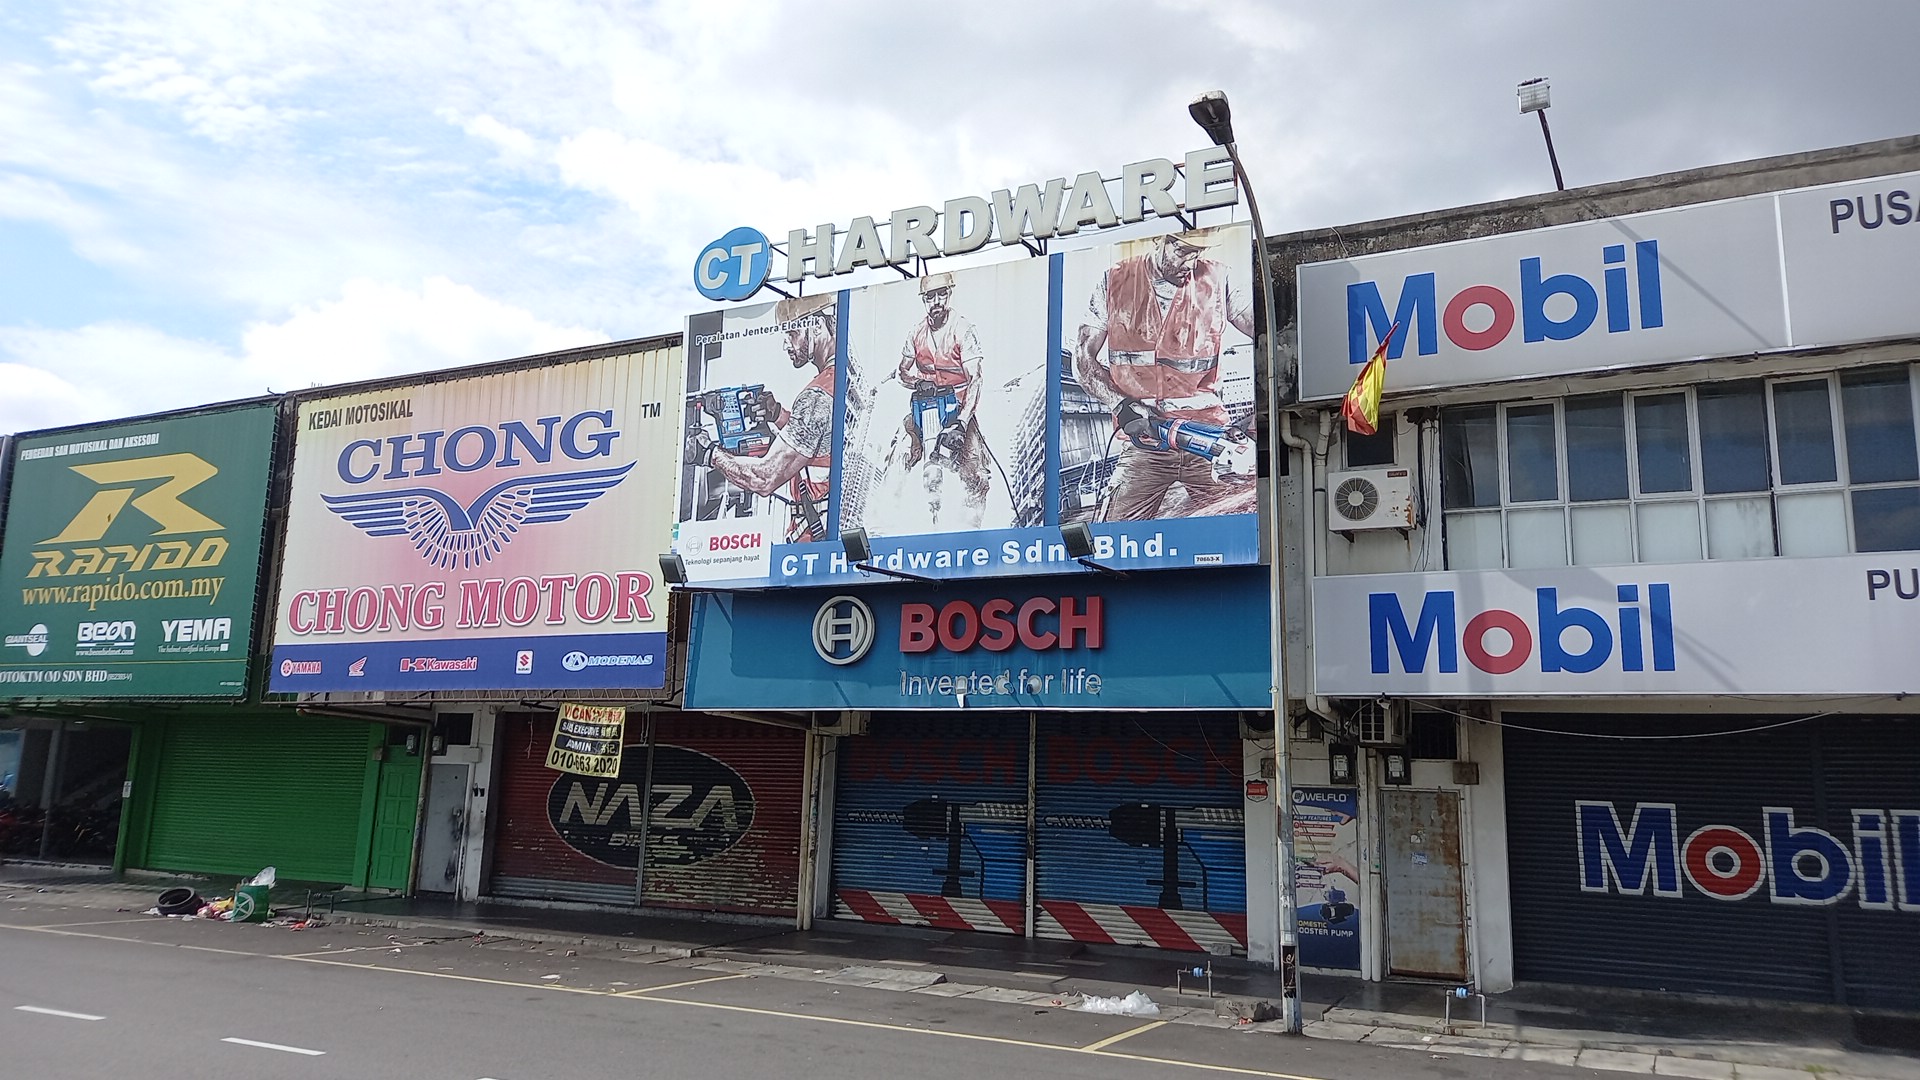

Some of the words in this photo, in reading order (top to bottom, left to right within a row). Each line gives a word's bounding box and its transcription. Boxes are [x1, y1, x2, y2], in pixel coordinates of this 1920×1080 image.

[787, 145, 1239, 284] HARDWARE
[1829, 190, 1920, 234] PUS
[698, 242, 763, 290] CT
[1346, 239, 1664, 365] Mobil
[695, 331, 741, 346] Peralatan
[742, 324, 779, 337] Jentera
[781, 317, 821, 331] Elektrik
[308, 408, 342, 430] KEDAI
[345, 399, 413, 426] MOTOSIKAL
[641, 402, 661, 419] TM
[69, 440, 108, 455] MOTOSIKAL
[109, 437, 124, 450] DAN
[124, 433, 160, 448] AKSESORI
[337, 409, 620, 484] CHONG
[709, 533, 761, 551] BOSCH
[781, 552, 819, 576] CT
[829, 548, 990, 574] Hrdware
[1094, 532, 1178, 560] Bhd.
[25, 537, 230, 578] RAPIDO
[685, 556, 711, 565] Teknologi
[713, 555, 742, 564] sepanjang
[744, 554, 760, 562] hayat
[22, 573, 226, 611] www.rapido.com.my
[287, 582, 446, 635] CHONG
[456, 571, 655, 629] MOTOR
[4, 634, 48, 643] GIANTSEAL
[161, 618, 231, 642] YEMA
[899, 596, 1103, 653] BOSCH
[1368, 583, 1676, 674] Mobil
[292, 661, 322, 674] YAMAHA
[425, 656, 478, 671] Kawasaki
[586, 654, 653, 667] MODENAS
[62, 670, 85, 682] SDN
[85, 670, 107, 682] BHD
[900, 669, 1010, 696] Invented
[1018, 668, 1054, 695] for
[1062, 667, 1102, 695] life
[593, 757, 618, 774] 2020
[848, 736, 1017, 787] BOSCH
[559, 781, 739, 829] NAZA
[1305, 792, 1347, 802] WELFLO
[1575, 800, 1920, 911] Mobil
[1297, 920, 1327, 928] OMESTIC
[1297, 927, 1328, 936] OOSTER
[1331, 929, 1354, 937] PUMP
